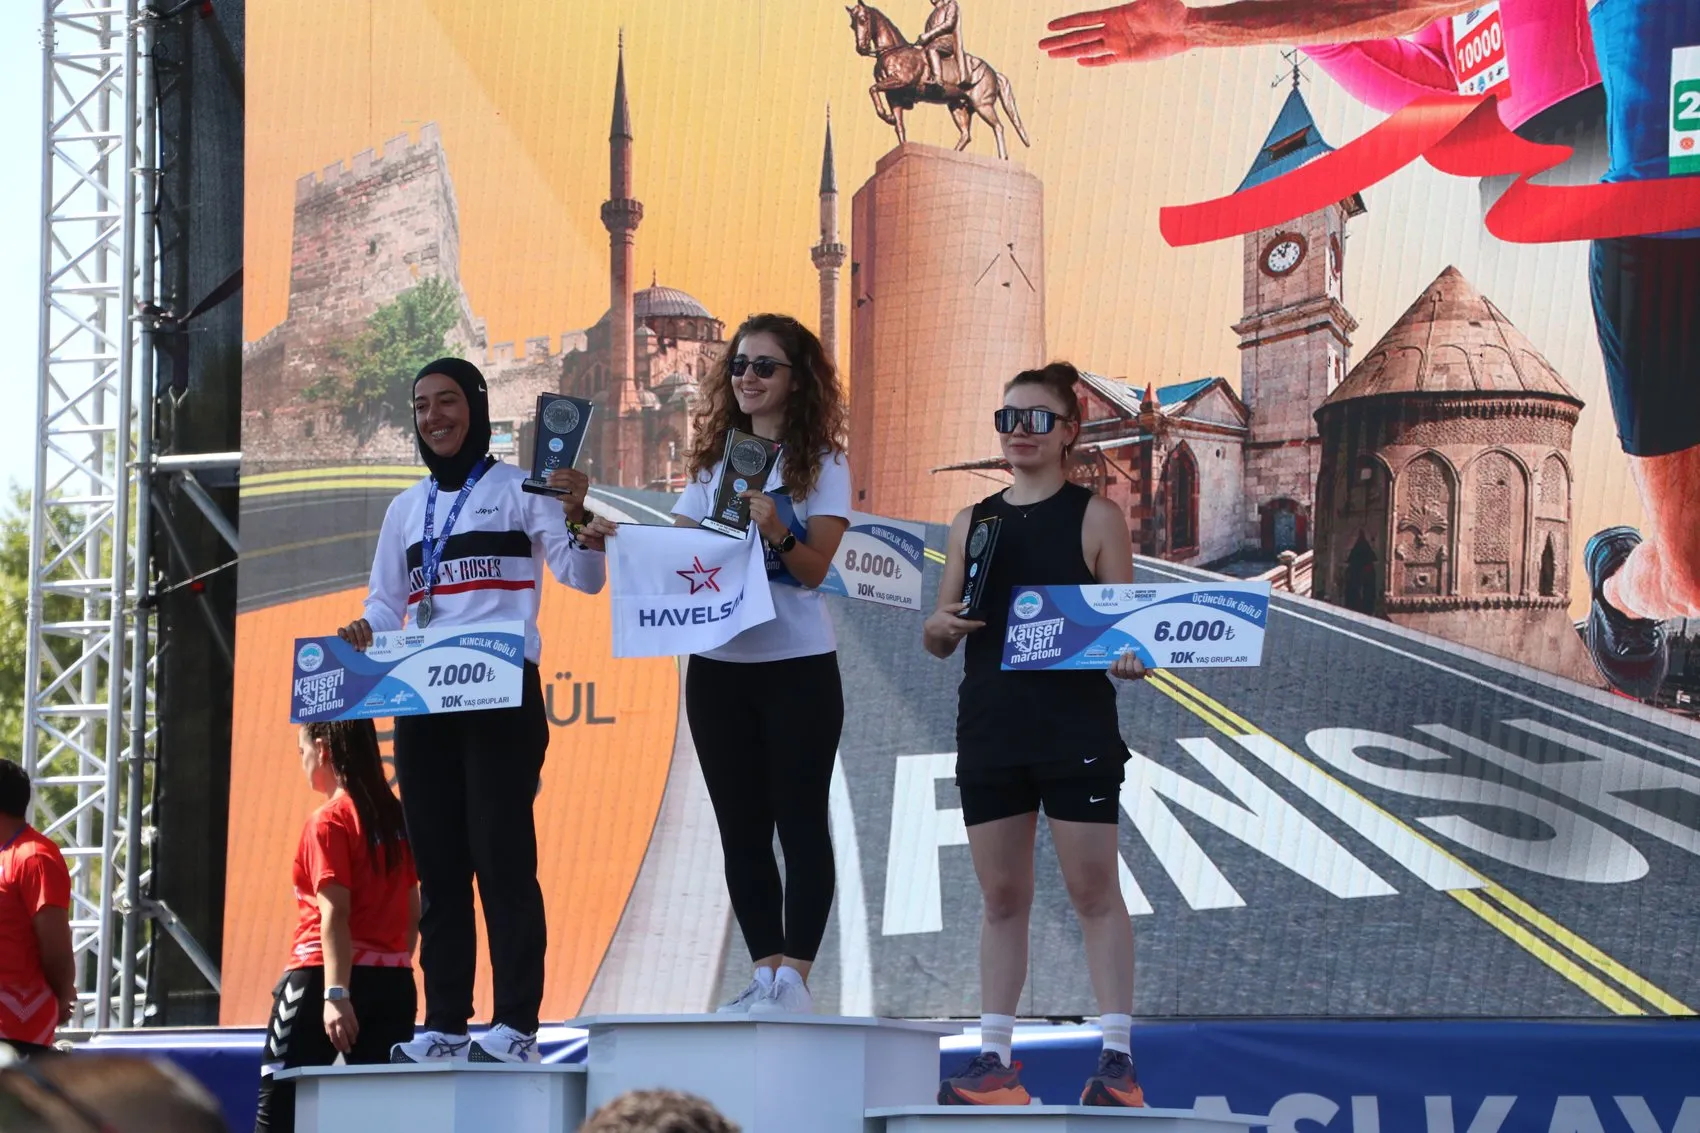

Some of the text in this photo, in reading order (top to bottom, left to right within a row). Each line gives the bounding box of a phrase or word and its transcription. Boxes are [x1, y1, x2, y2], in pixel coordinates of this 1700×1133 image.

[1458, 21, 1502, 73] 10000
[459, 558, 502, 581] ROSES
[857, 582, 876, 598] 10K
[885, 593, 913, 604] GRUPLARI
[1192, 592, 1262, 619] ÜÇÜNCÜLÜK ÖDÜLÜ
[1007, 617, 1065, 643] Kayseri
[459, 637, 518, 658] İKİNCİLİK ÖDÜLÜ
[1010, 648, 1062, 664] maratonu
[1170, 651, 1248, 664] 10K YAŞ GRUPLARI
[294, 667, 345, 697] Kayseri
[299, 698, 344, 718] maratonu
[441, 694, 510, 709] 10K YAŞ GRUPLARI
